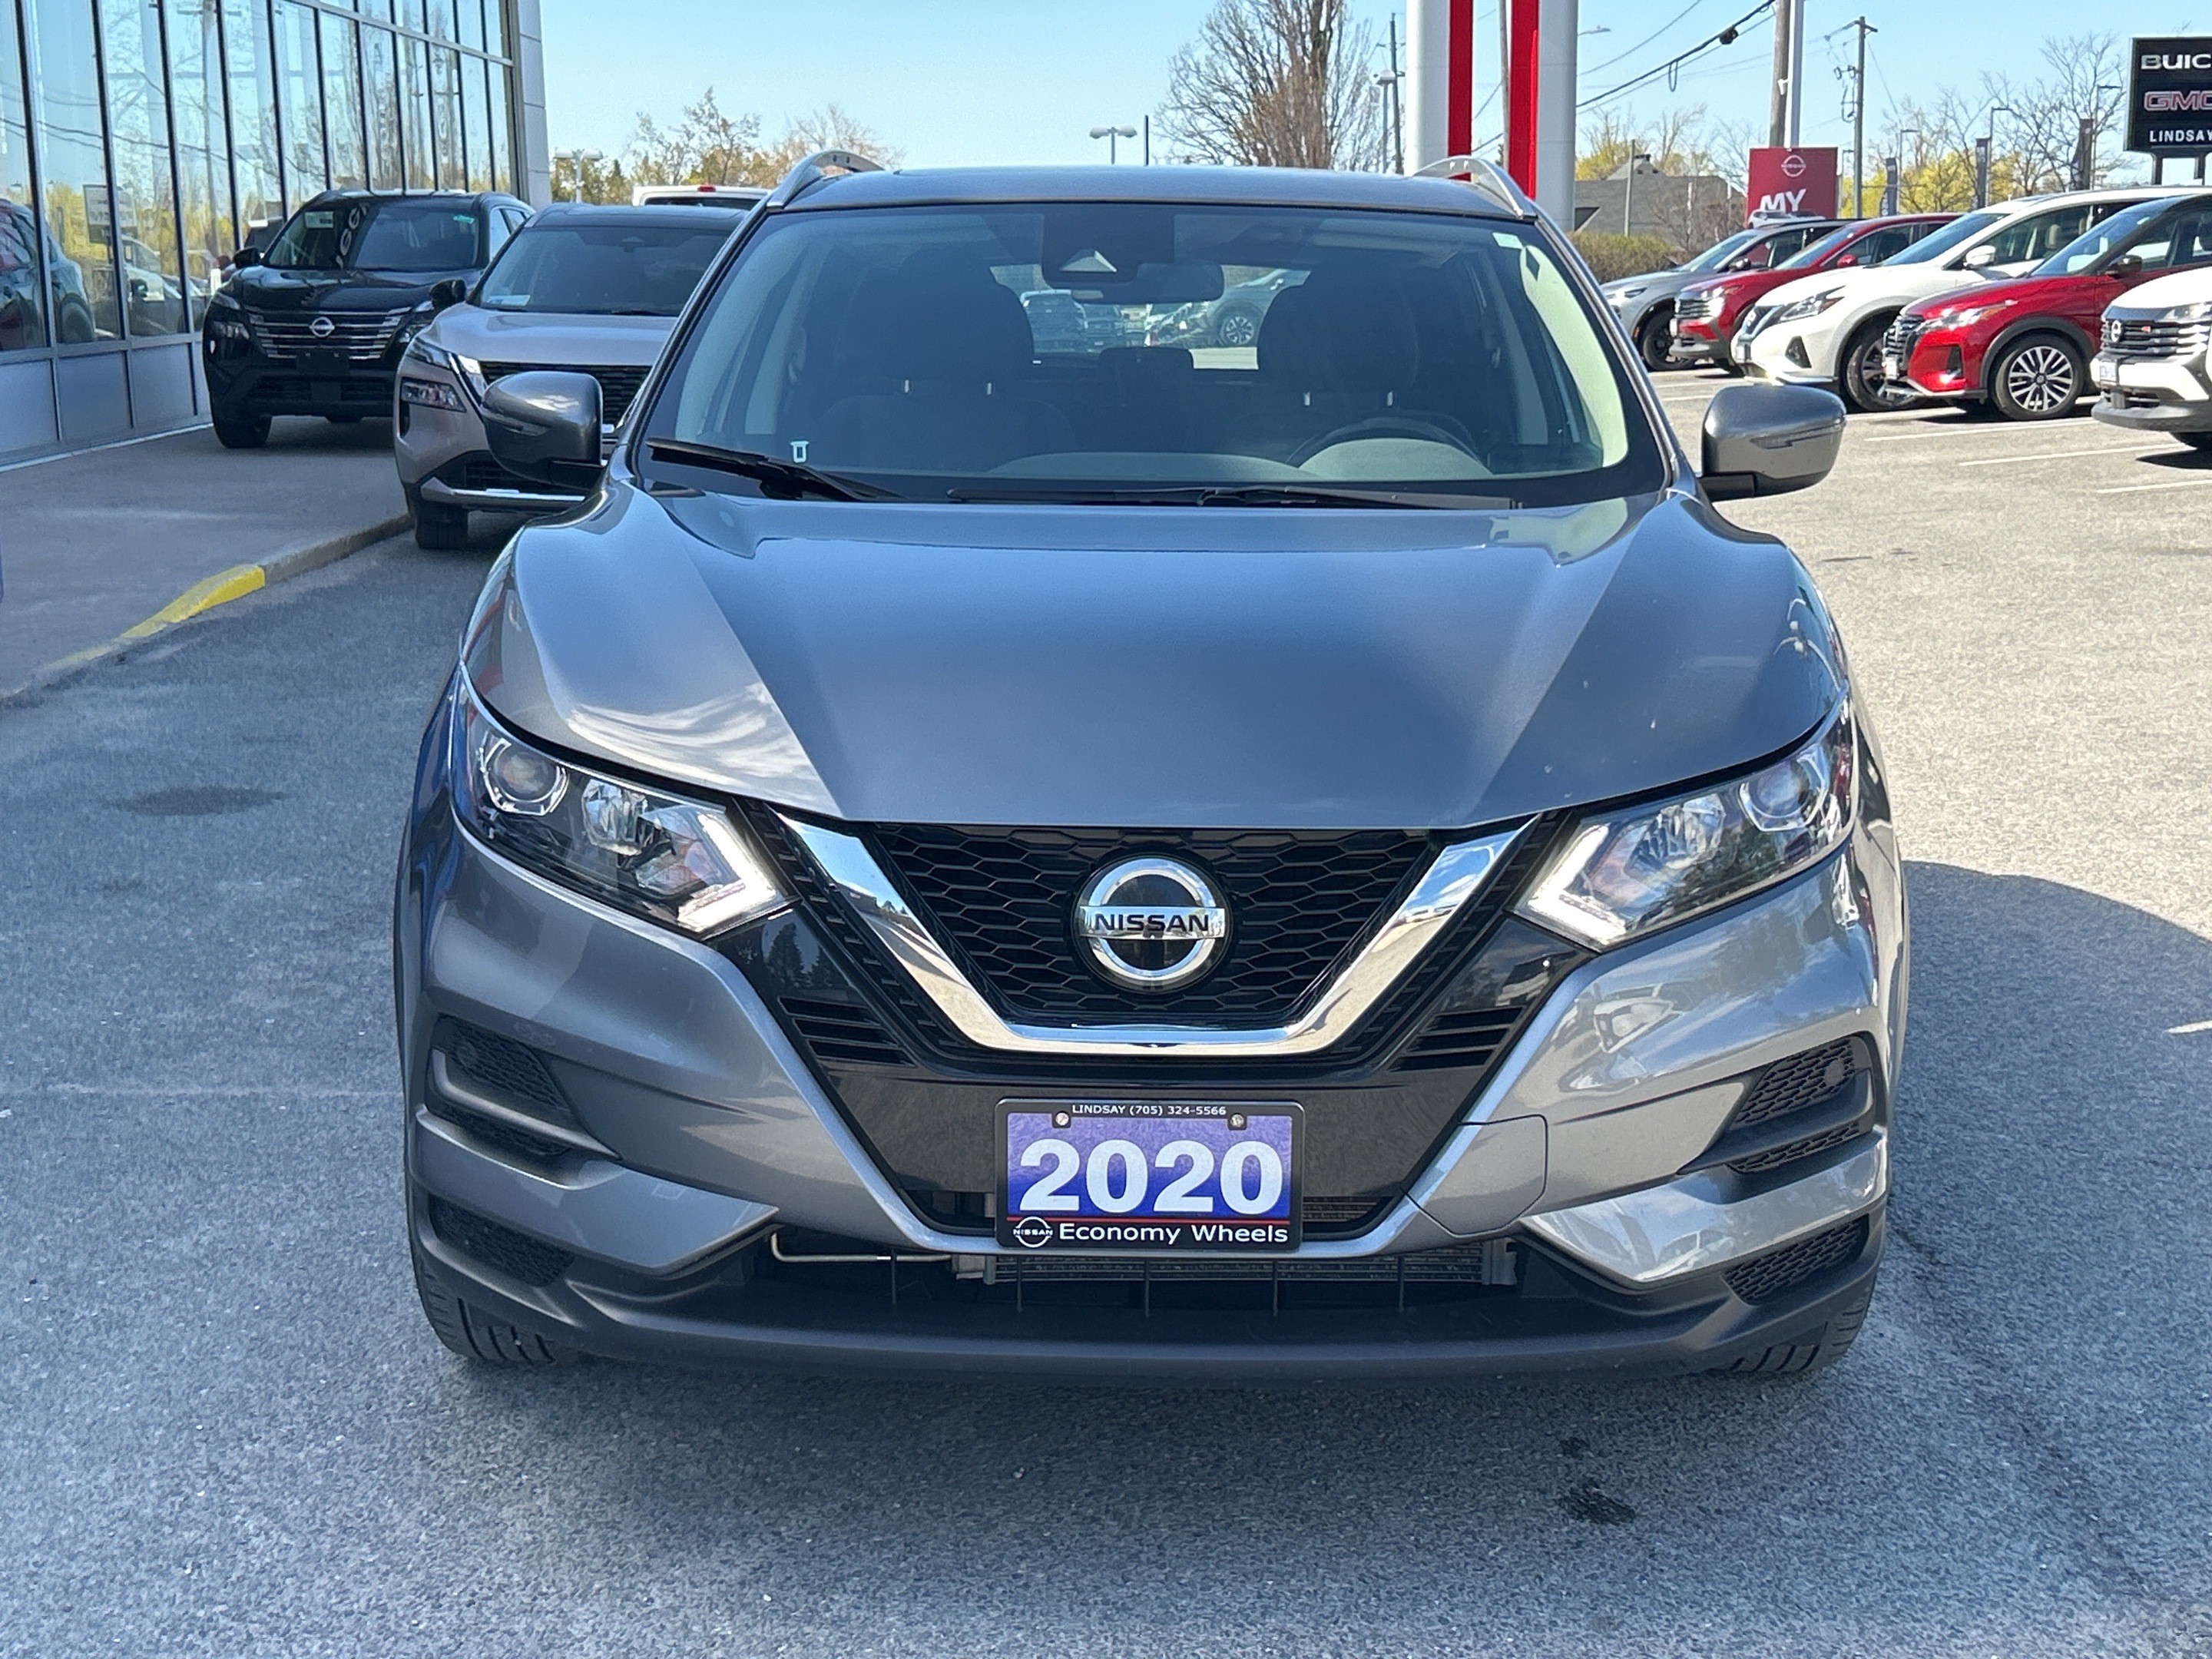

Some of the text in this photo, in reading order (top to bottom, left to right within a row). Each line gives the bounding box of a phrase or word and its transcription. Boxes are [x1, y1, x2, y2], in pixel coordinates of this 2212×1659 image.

[1760, 188, 1807, 215] MY
[1094, 913, 1209, 932] NISSAN
[1071, 1104, 1227, 1116] LINDSAY (705) 324-5566
[1019, 1137, 1283, 1214] 2020
[1058, 1223, 1288, 1245] Economy Wheels
